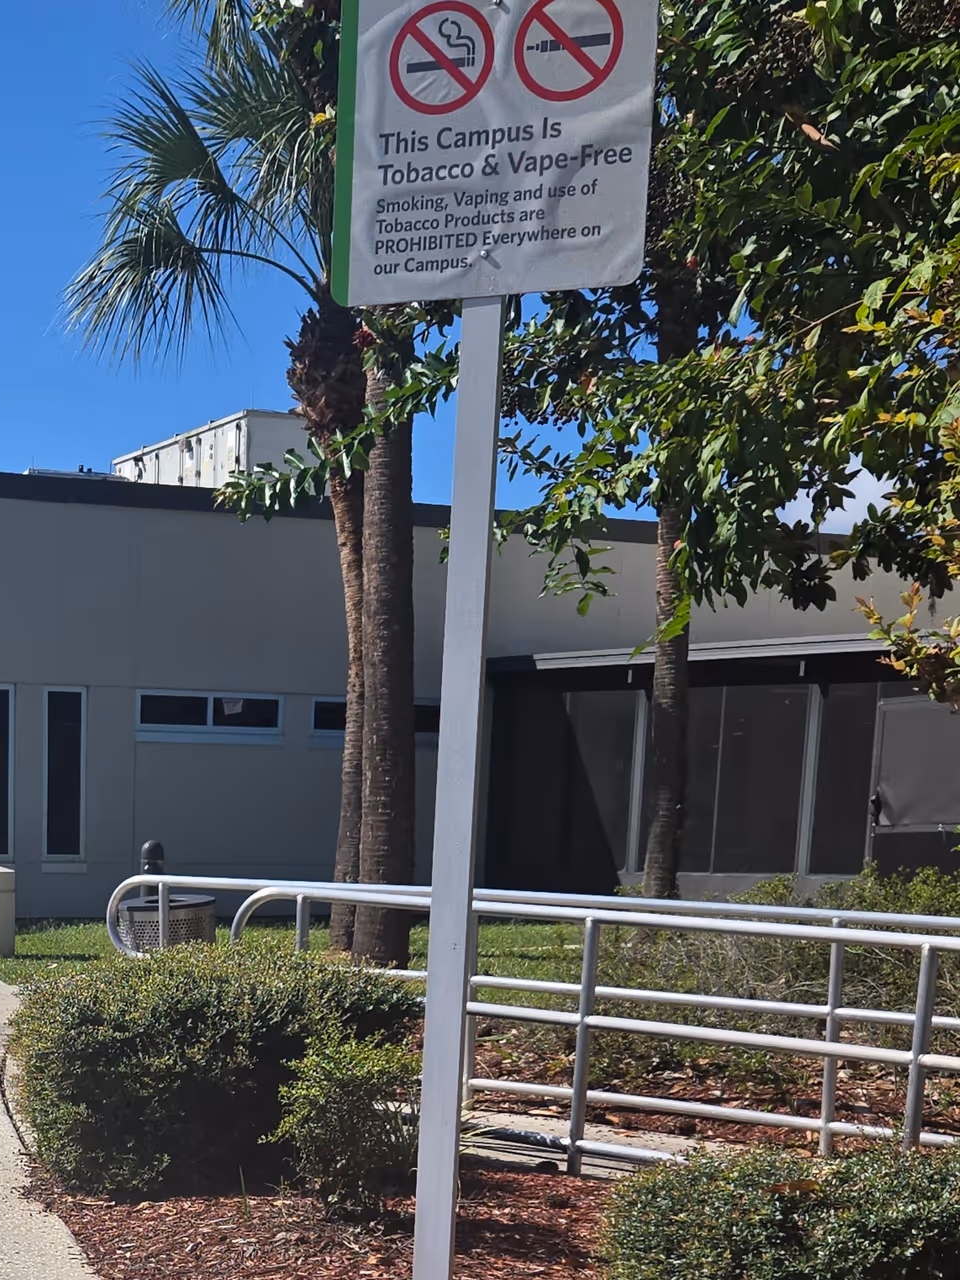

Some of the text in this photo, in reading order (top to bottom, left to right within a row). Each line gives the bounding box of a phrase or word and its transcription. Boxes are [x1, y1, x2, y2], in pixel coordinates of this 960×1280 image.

[379, 117, 562, 155] This Campus Is
[378, 143, 633, 186] Tobacco & Vape-Free
[376, 179, 598, 214] Smoking, Vaping and use of
[376, 208, 545, 234] Tobacco Products are
[375, 224, 602, 255] PROHIBITED Everywhere on
[373, 256, 473, 276] our Campus.
